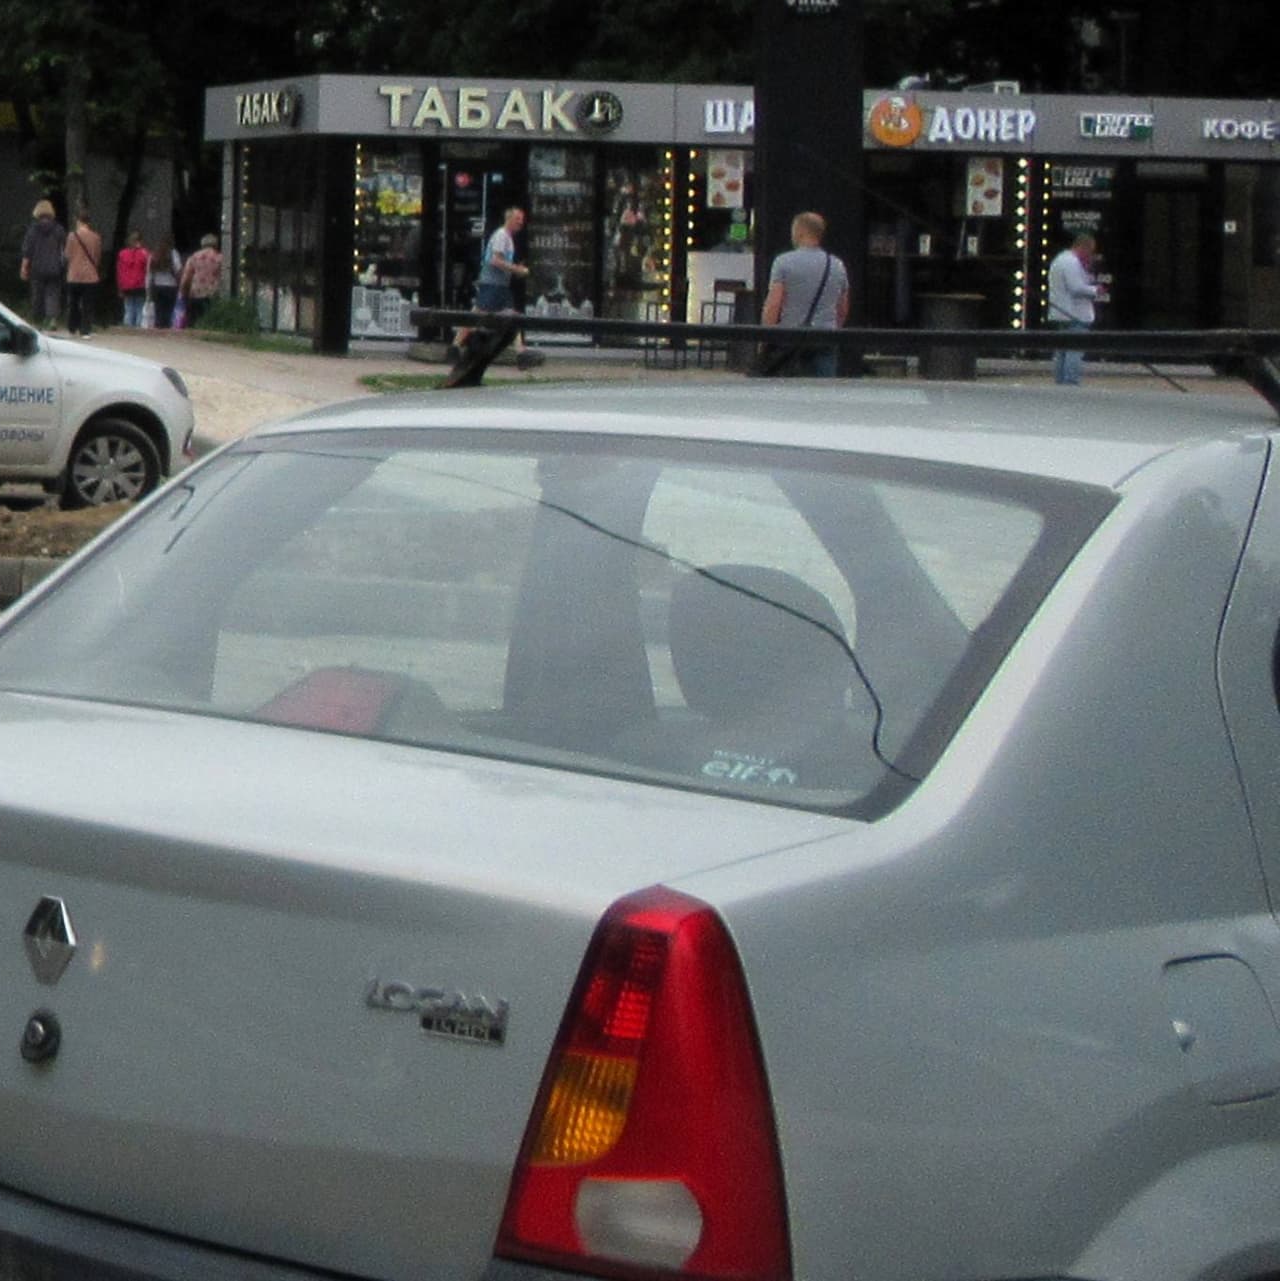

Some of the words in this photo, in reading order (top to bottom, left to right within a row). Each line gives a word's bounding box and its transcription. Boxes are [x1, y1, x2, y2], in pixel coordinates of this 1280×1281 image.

[236, 91, 281, 125] ТАБАК
[379, 85, 577, 132] ТАБАК
[1097, 113, 1153, 126] COFFEE
[928, 107, 1036, 143] ДОНЕР
[1095, 124, 1132, 137] LIKE
[1203, 119, 1276, 139] КОФЕ
